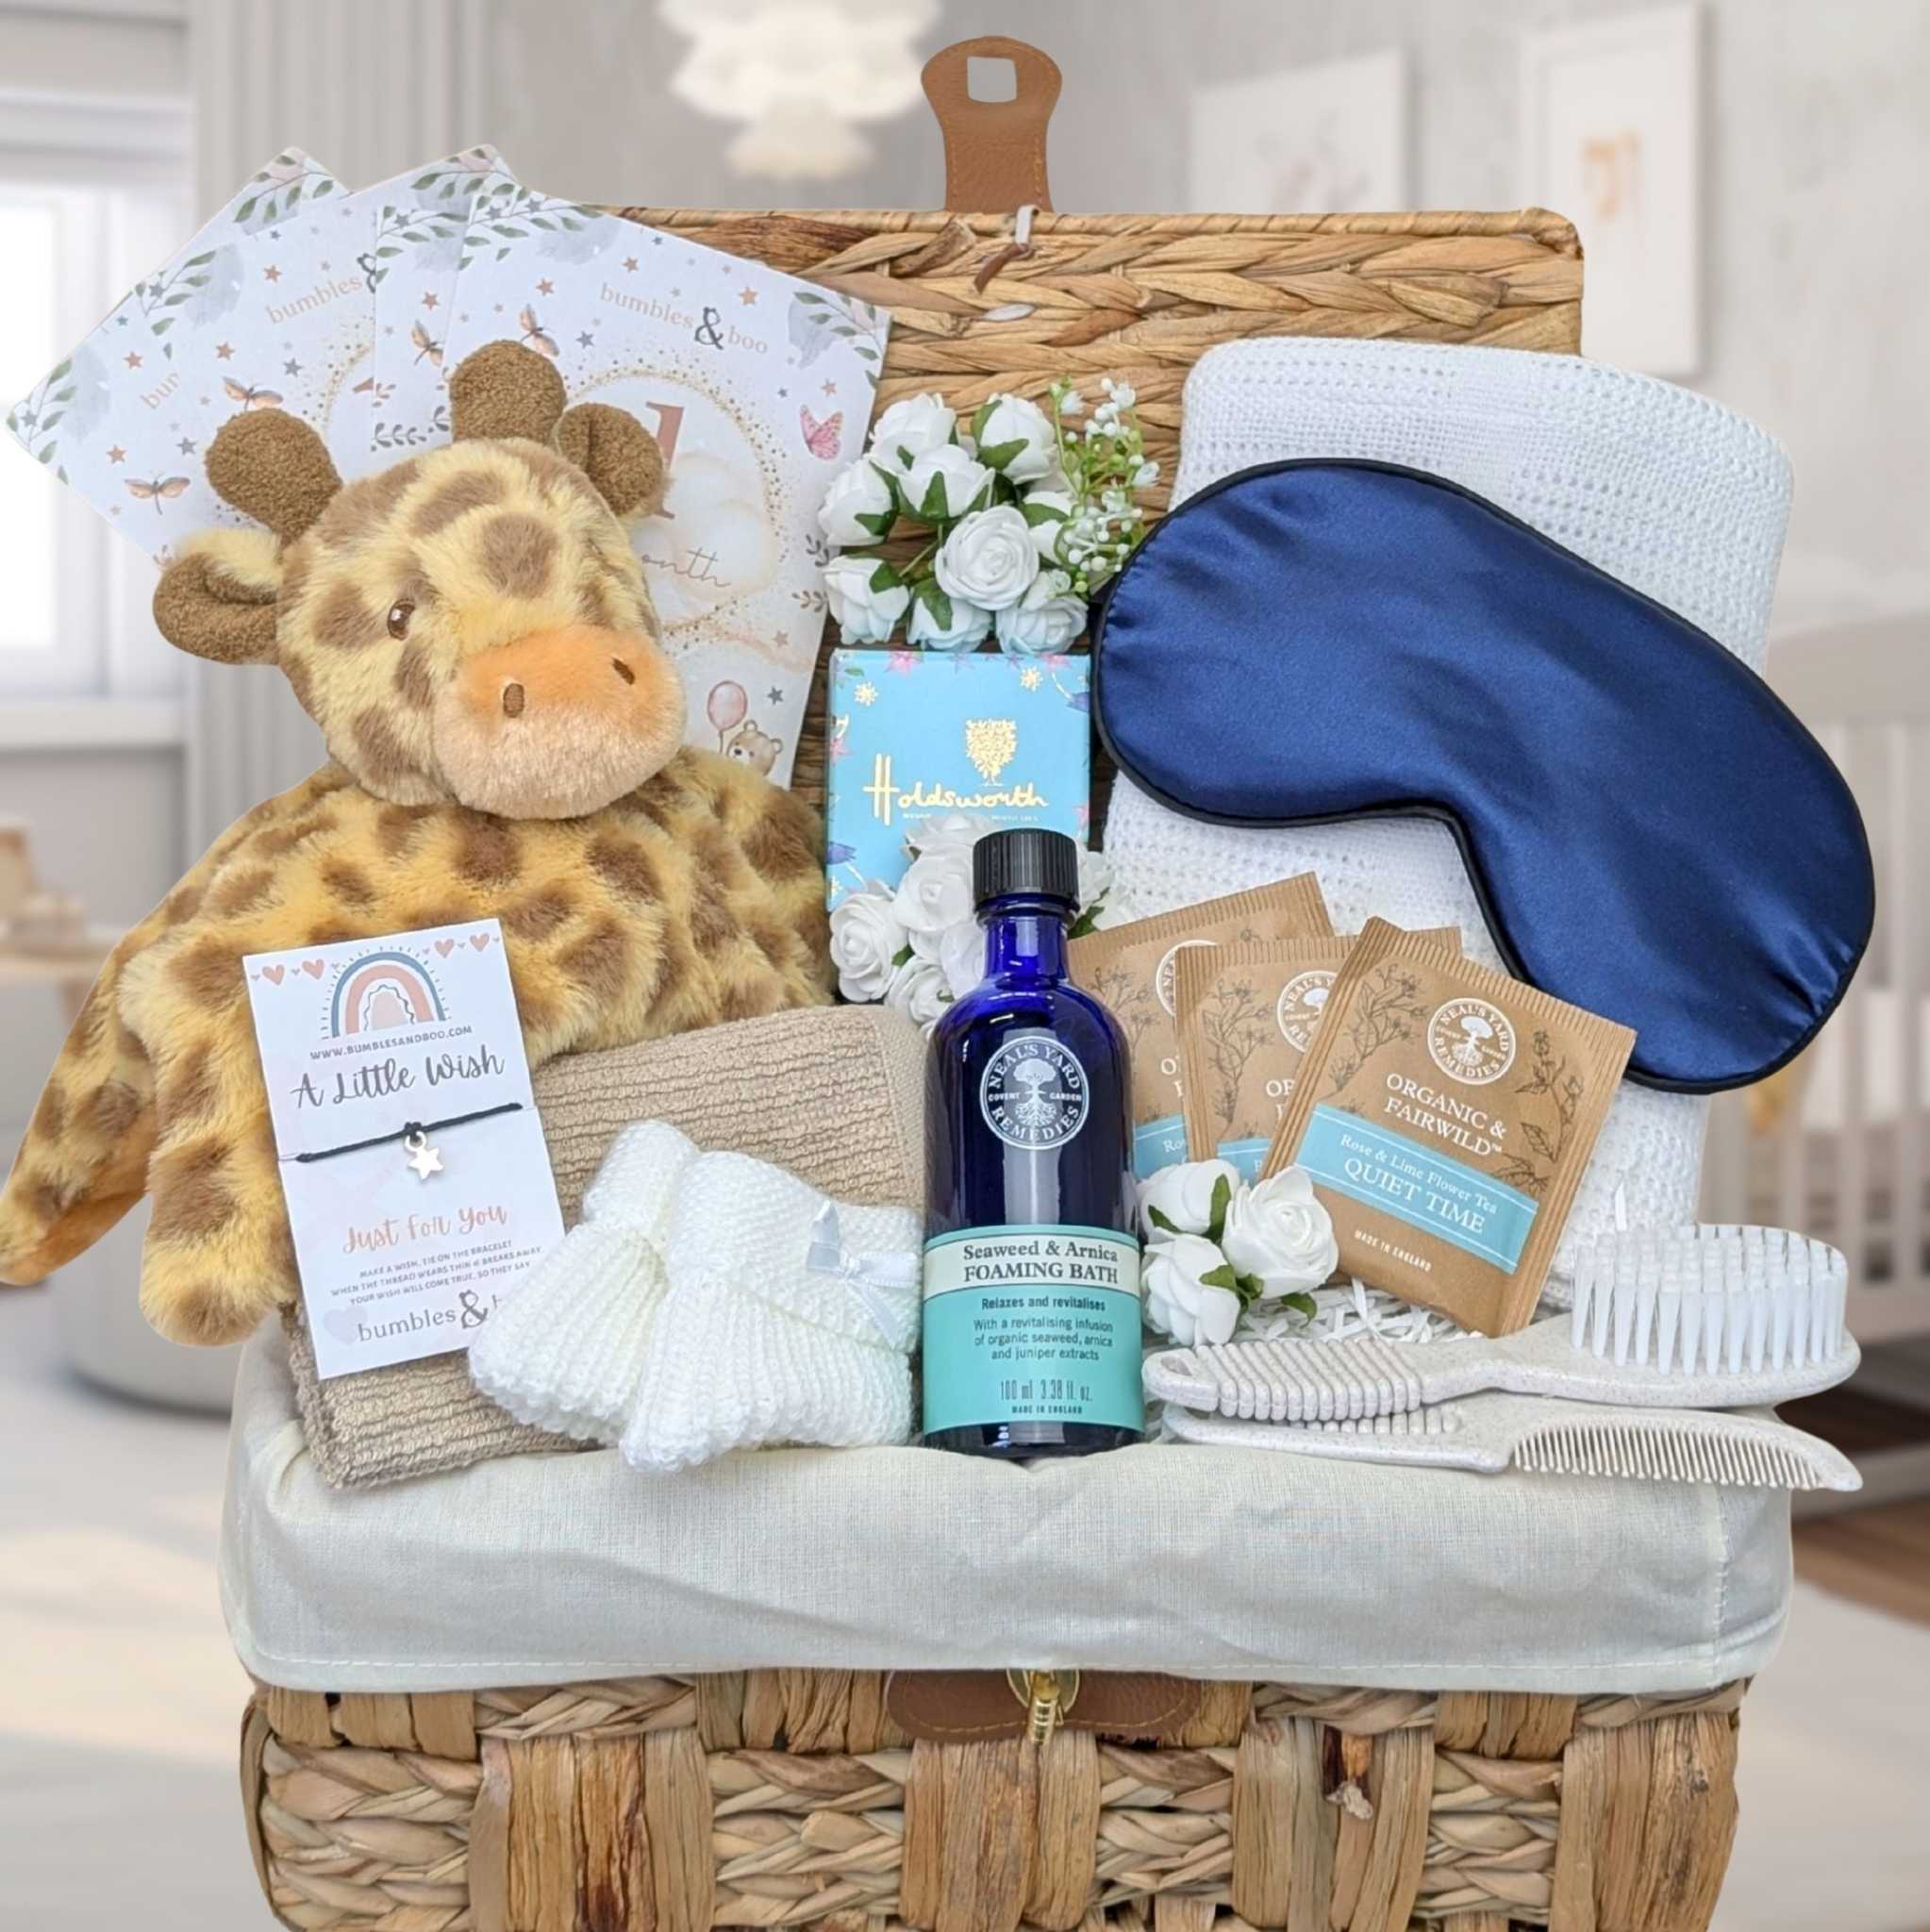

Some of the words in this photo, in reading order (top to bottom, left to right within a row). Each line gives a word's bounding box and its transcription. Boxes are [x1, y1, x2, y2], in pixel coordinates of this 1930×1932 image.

[265, 277, 364, 325] bumbles
[600, 282, 694, 328] bumbles
[694, 307, 724, 350] &
[727, 326, 769, 354] boo
[641, 547, 731, 587] onth
[863, 754, 1049, 825] Holdsworth
[310, 1025, 473, 1060] WWW.BUMBLESANDBOO.COM
[1489, 1014, 1509, 1052] YARD
[290, 1073, 324, 1108] A
[333, 1058, 416, 1105] Little
[425, 1044, 505, 1086] Wish
[988, 1043, 1039, 1090] NEAL'S
[1043, 1045, 1081, 1090] YARD
[1435, 1037, 1500, 1077] REMEDIES
[988, 1092, 1021, 1102] COVENT
[1049, 1092, 1082, 1102] GARDEN
[1386, 1074, 1487, 1128] ORGANIC
[1489, 1120, 1507, 1140] &
[991, 1105, 1079, 1141] REMEDIES
[1340, 1133, 1373, 1156] Rose
[1374, 1150, 1389, 1162] &
[1390, 1155, 1424, 1179] Lime
[1427, 1171, 1472, 1202] Flower
[1475, 1193, 1497, 1214] Tea
[1344, 1157, 1422, 1202] QUIET
[1425, 1191, 1486, 1234] TIME
[342, 1218, 399, 1254] Just
[963, 1241, 1039, 1260] Seaweed
[1045, 1241, 1060, 1257] &
[1065, 1241, 1118, 1262] Arnica
[1355, 1229, 1377, 1246] MADE
[1381, 1241, 1389, 1254] IN
[1392, 1247, 1432, 1272] ENGLAND
[331, 1285, 359, 1296] WHEN
[361, 1281, 377, 1291] THE
[381, 1274, 416, 1286] THREAD
[418, 1266, 447, 1278] WEARS
[450, 1261, 471, 1271] THIN
[482, 1253, 515, 1265] BREAKS
[359, 1267, 384, 1278] MAKE
[423, 1257, 436, 1266] TIE
[438, 1254, 451, 1262] ON
[454, 1250, 470, 1259] THE
[471, 1241, 512, 1256] BRACELET
[963, 1262, 1063, 1283] FOAMING
[1069, 1263, 1119, 1284] BATH
[350, 1294, 374, 1306] YOUR
[377, 1289, 401, 1299] WISH
[403, 1285, 424, 1294] WILL
[425, 1278, 449, 1290] COME
[477, 1270, 490, 1278] SO
[491, 1264, 512, 1276] THEY
[981, 1297, 1024, 1310] Relaxes
[1028, 1296, 1049, 1307] and
[1052, 1296, 1106, 1311] revitalises
[358, 1308, 457, 1342] bumbles
[458, 1289, 489, 1329] &
[973, 1319, 998, 1331] With
[1001, 1320, 1007, 1328] a
[1010, 1317, 1072, 1330] revitalising
[1075, 1318, 1113, 1333] infusion
[974, 1333, 985, 1346] of
[988, 1332, 1027, 1346] organic
[1032, 1332, 1082, 1345] seaweed,
[1085, 1334, 1113, 1346] arnica
[991, 1348, 1011, 1359] and
[1015, 1347, 1056, 1361] juniper
[1059, 1348, 1100, 1361] extracts
[1001, 1380, 1017, 1400] 100
[1022, 1379, 1033, 1399] ml
[1040, 1379, 1063, 1400] 3.38
[1012, 1406, 1033, 1414] MADE
[1036, 1406, 1045, 1414] IN
[1048, 1406, 1083, 1414] ENGLAND
